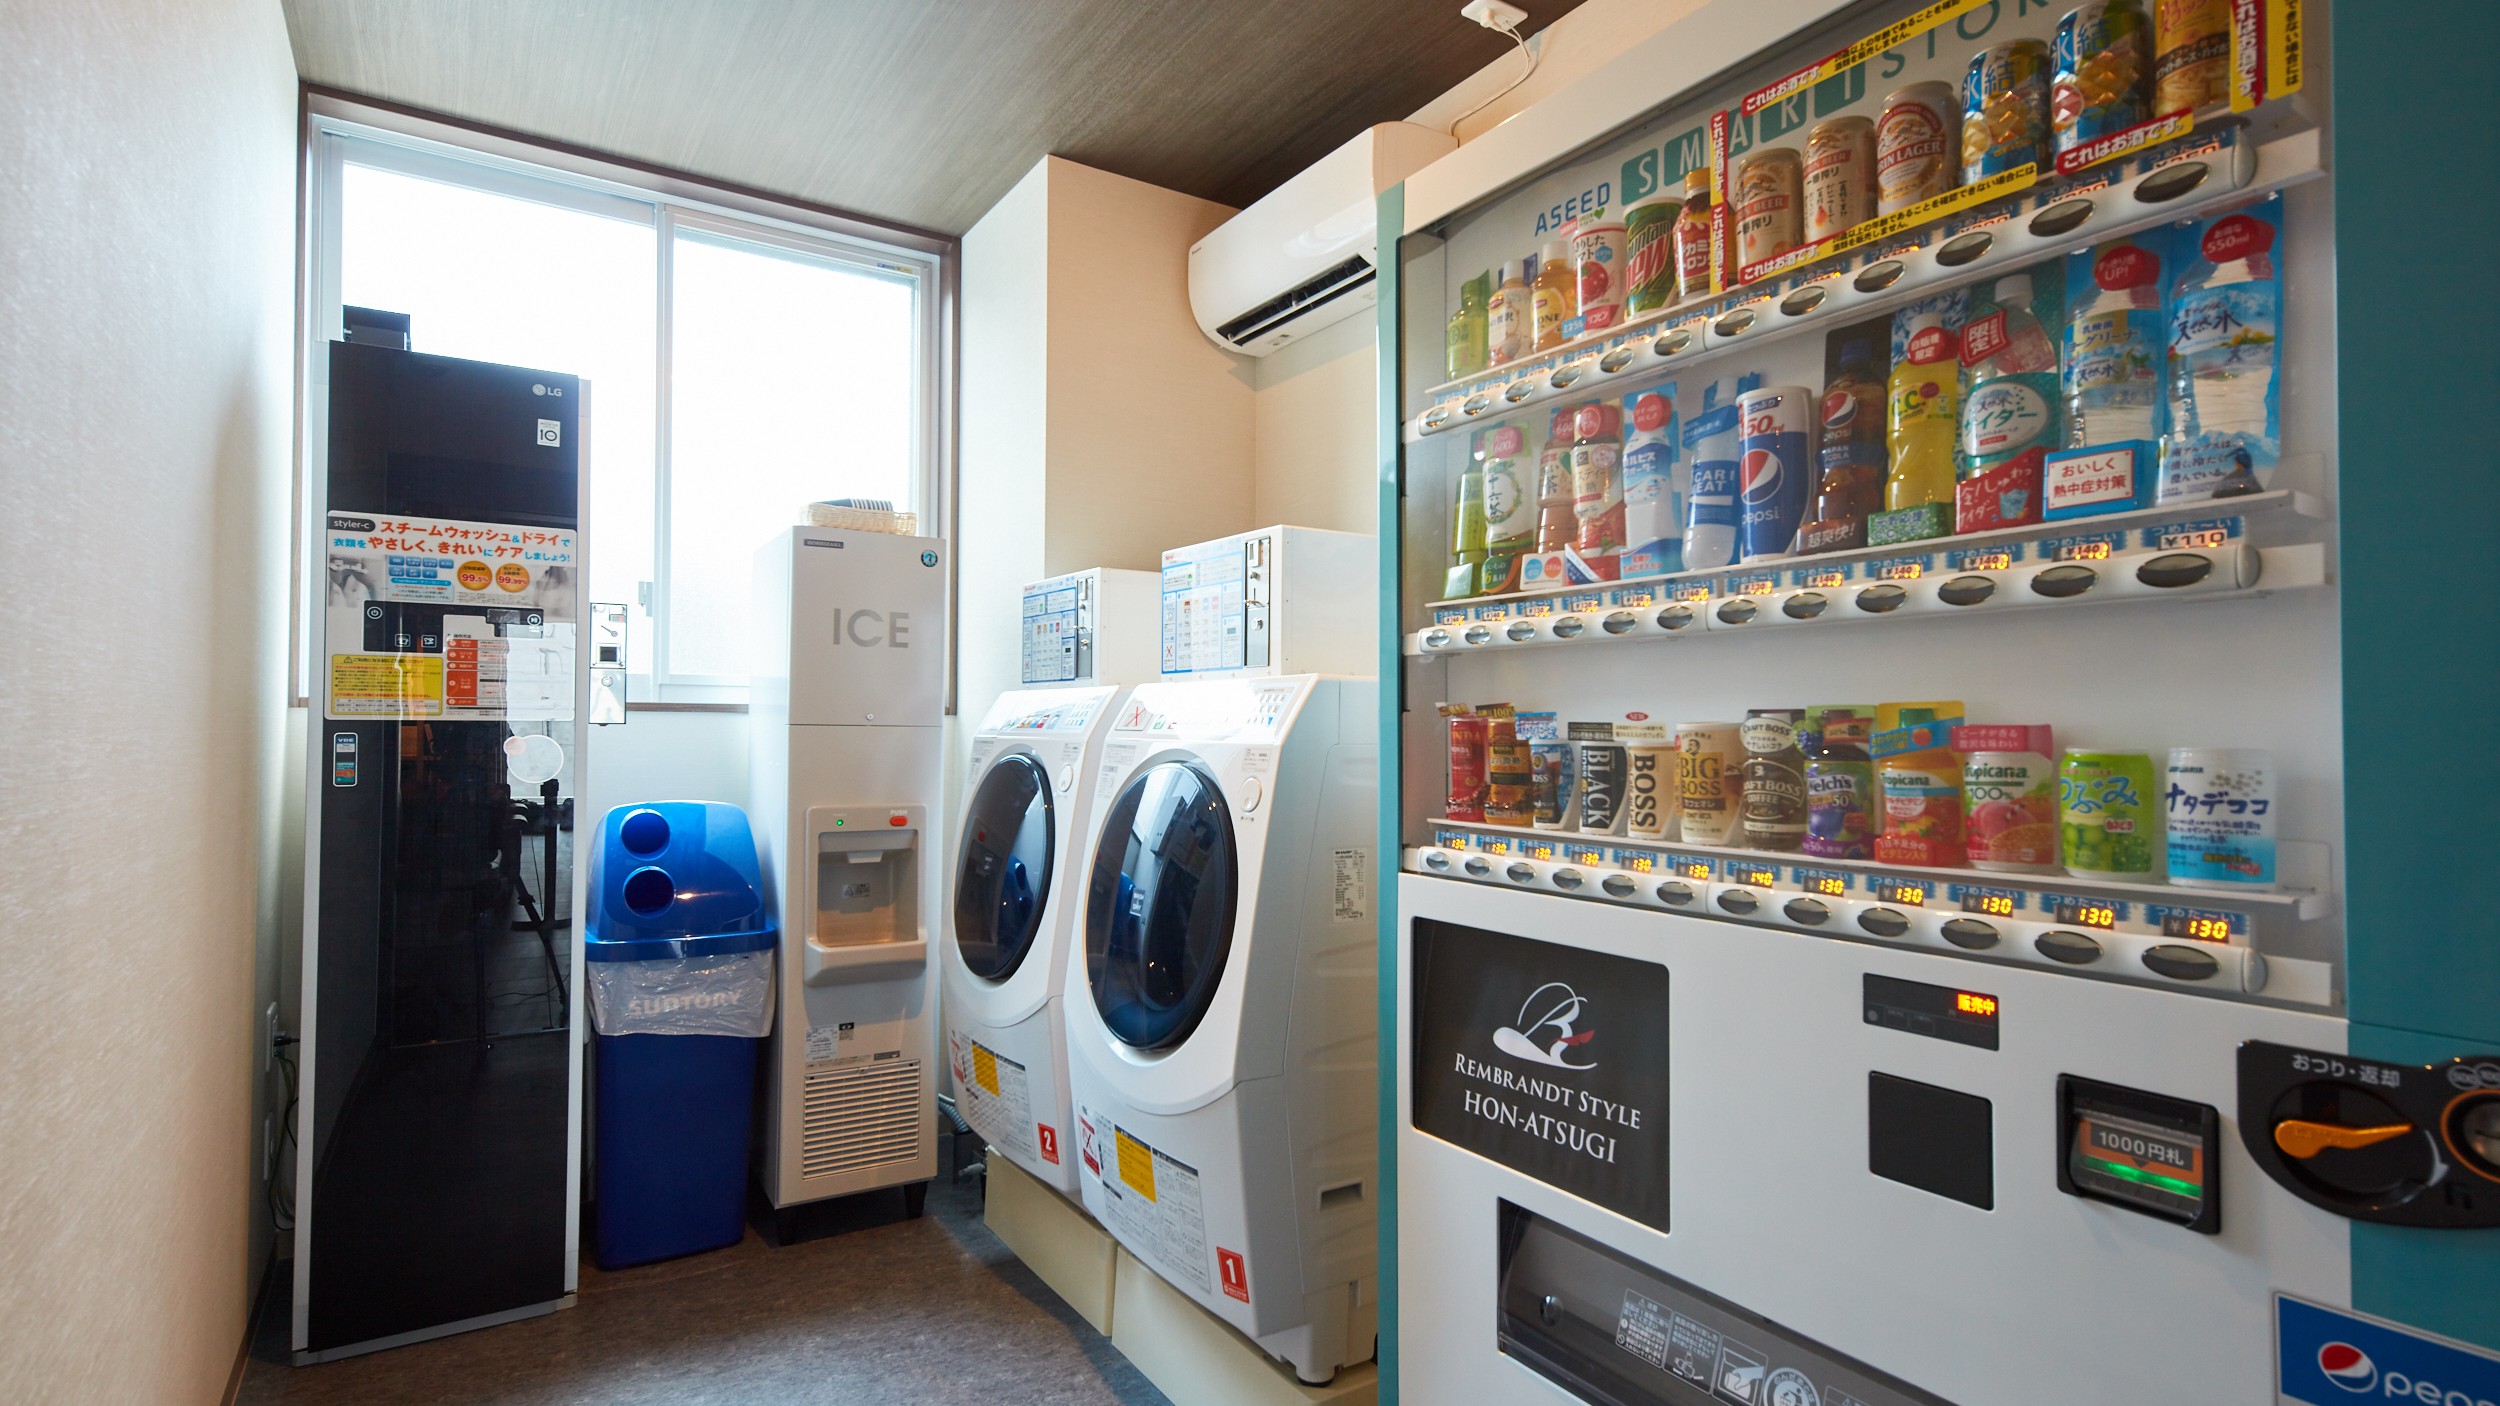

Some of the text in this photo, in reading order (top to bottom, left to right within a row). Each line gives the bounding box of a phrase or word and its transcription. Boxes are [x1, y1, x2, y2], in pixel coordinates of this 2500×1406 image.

[1746, 65, 1823, 111] これはお酒です。
[1897, 141, 1941, 161] LAGER
[2064, 116, 2184, 169] これはお酒です。
[1806, 166, 1840, 185] 一番搾り
[1535, 182, 1611, 237] ASEED
[1755, 197, 1784, 211] BEER
[1736, 215, 1773, 236] 一番搾り
[2206, 233, 2250, 254] 550ml
[1744, 243, 1821, 282] これはお酒です。
[2105, 266, 2129, 281] UP!
[1587, 310, 1609, 325] リコピン
[2174, 310, 2243, 346] 天然水
[547, 386, 563, 398] LG
[2061, 456, 2117, 479] おいしく
[2053, 474, 2128, 498] 熱中症対策
[1487, 474, 1505, 519] 十六茶
[333, 518, 370, 530] styler-c
[380, 520, 571, 548] スチームウォッシュ&ドライで
[2152, 519, 2232, 537] つめた〜い
[333, 535, 571, 563] 衣類をやさしく、きれいにケアしましょう!
[2046, 532, 2117, 548] つめた〜い
[1872, 555, 1928, 569] つめた〜い
[1953, 545, 2017, 560] つめた〜い
[461, 573, 489, 584] 99.5%
[498, 575, 529, 587] 99.99%
[832, 608, 910, 649] ICE
[1765, 723, 1792, 736] BOSS
[1681, 757, 1720, 780] BIG
[1587, 750, 1611, 825] BLACK
[1682, 780, 1722, 796] BOSS
[1765, 780, 1802, 797] BOSS
[1880, 772, 1931, 787] Tropicana
[1634, 753, 1657, 828] BOSS
[1969, 786, 2014, 801] 100%
[2165, 782, 2269, 816] ナタデココ
[1732, 861, 1777, 874] つめた〜い
[1799, 868, 1849, 881] つめた〜い
[1874, 876, 1929, 890] つめた〜い
[1956, 884, 2019, 900] つめた〜い
[2050, 894, 2120, 909] つめた〜い
[2156, 905, 2235, 923] つめた〜い
[1957, 993, 1996, 1016] 販売中
[2292, 1054, 2401, 1089] おつり・返却
[1455, 1053, 1641, 1130] REMBRANDT STYLE
[1464, 1090, 1616, 1163] HON-ATSUGI
[1043, 1129, 1053, 1152] 2
[2100, 1131, 2185, 1166] 1000円札
[1225, 1257, 1237, 1285] 1
